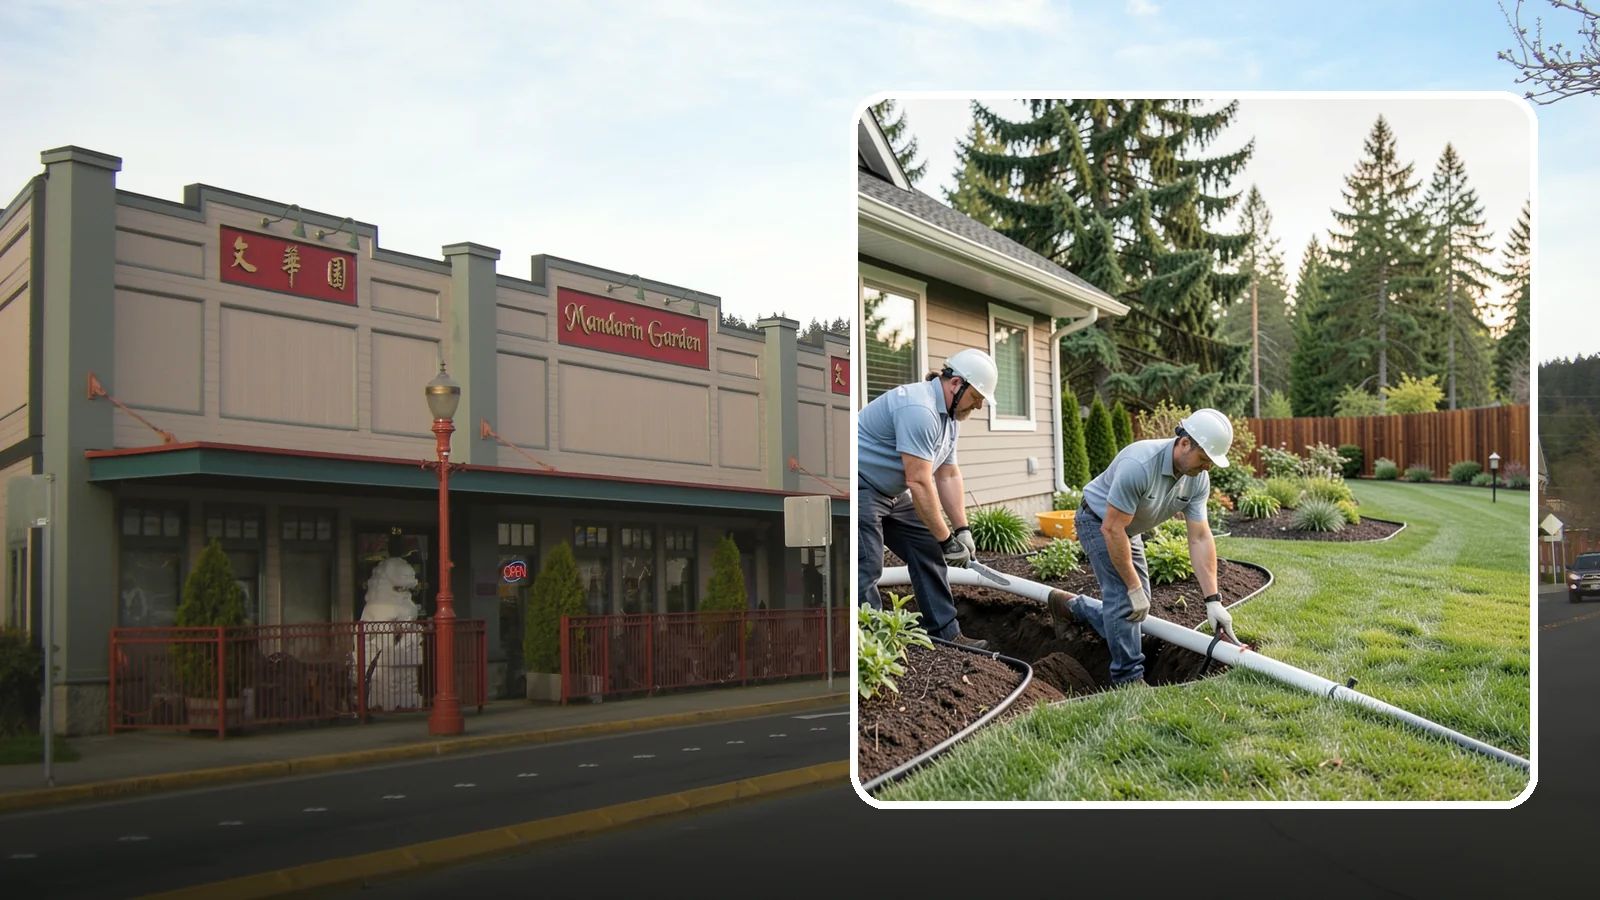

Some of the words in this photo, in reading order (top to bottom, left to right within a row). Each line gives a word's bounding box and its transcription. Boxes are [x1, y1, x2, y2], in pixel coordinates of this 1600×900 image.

[230, 235, 347, 291] 文華園
[564, 302, 644, 341] Mandarin
[648, 320, 702, 352] Garden
[503, 565, 527, 578] OPEN
